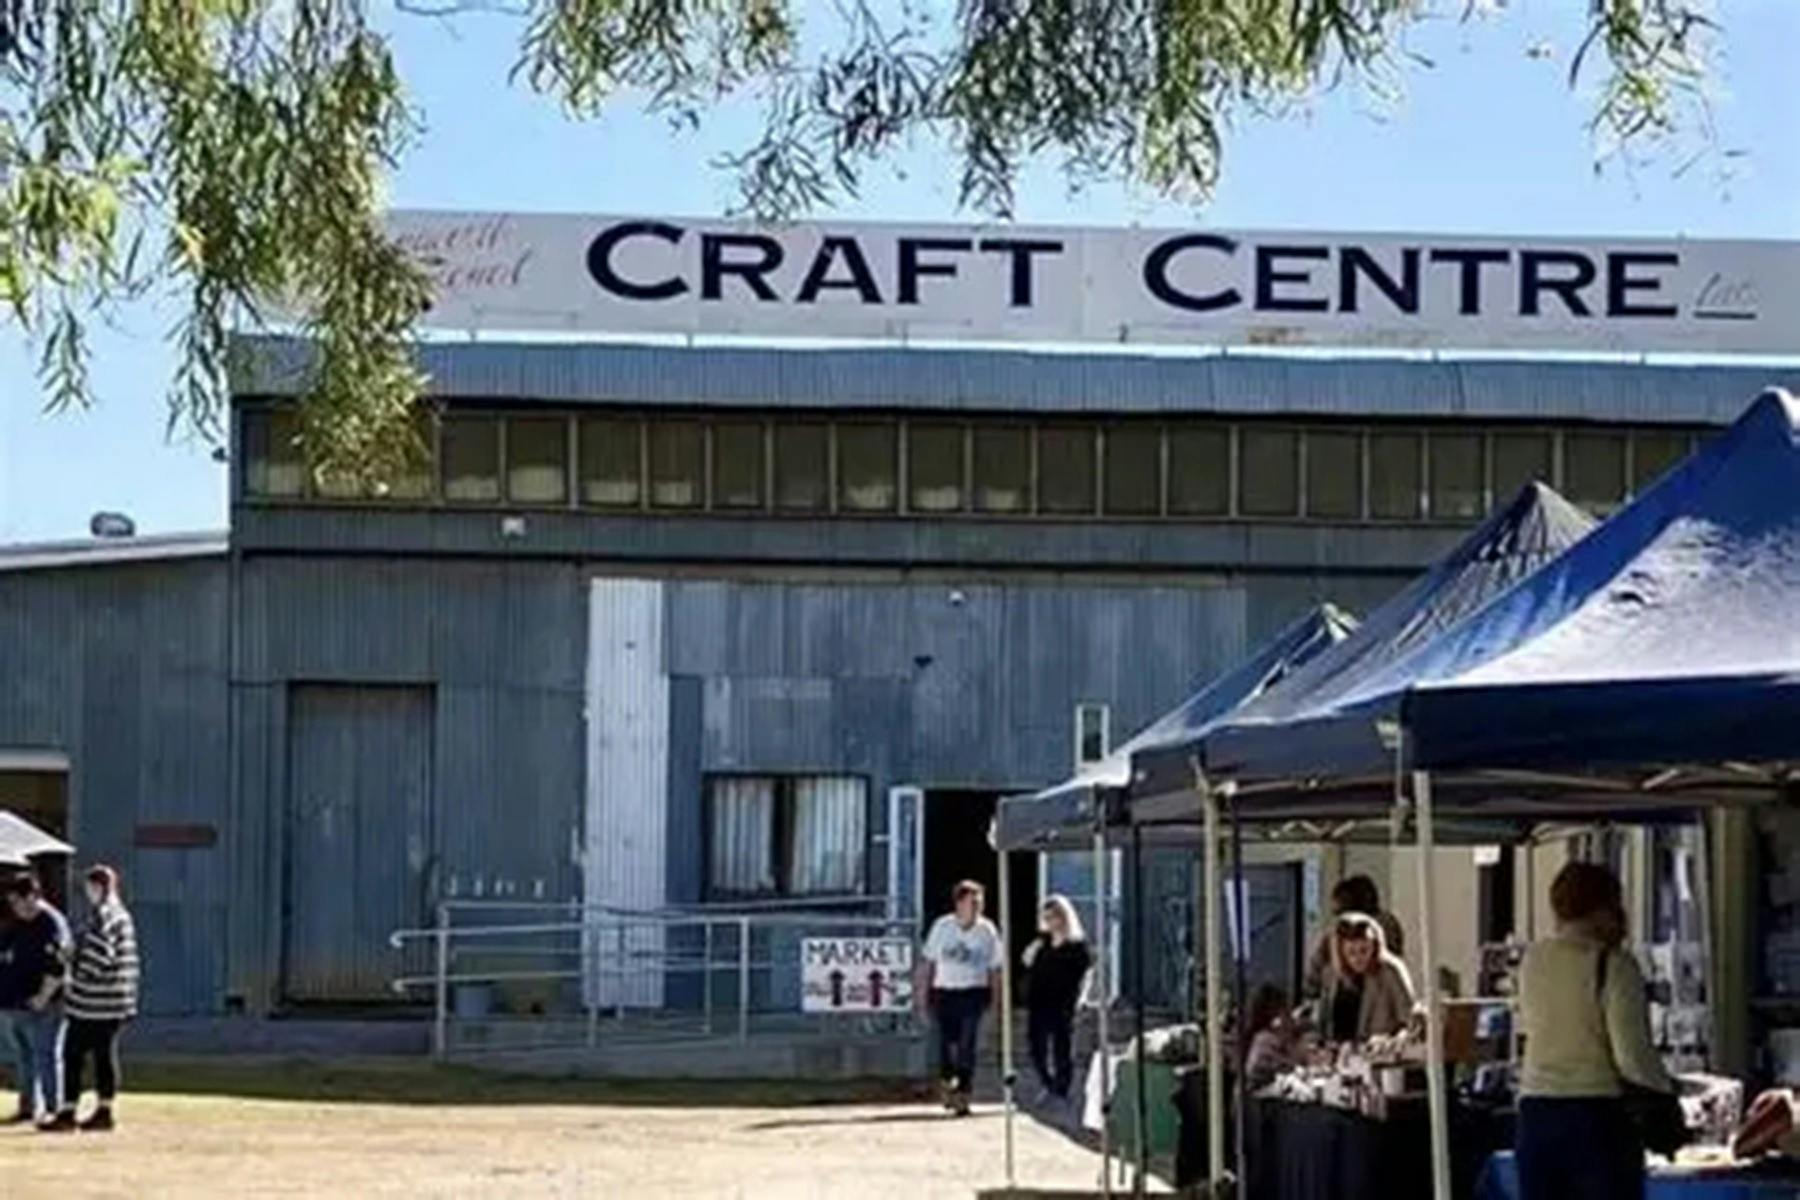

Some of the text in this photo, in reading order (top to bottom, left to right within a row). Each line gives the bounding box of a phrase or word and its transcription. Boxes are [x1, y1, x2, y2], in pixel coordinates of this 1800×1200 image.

[586, 221, 1065, 307] CRAFT
[1143, 234, 1680, 318] CENTRE
[807, 941, 907, 965] MARKET
